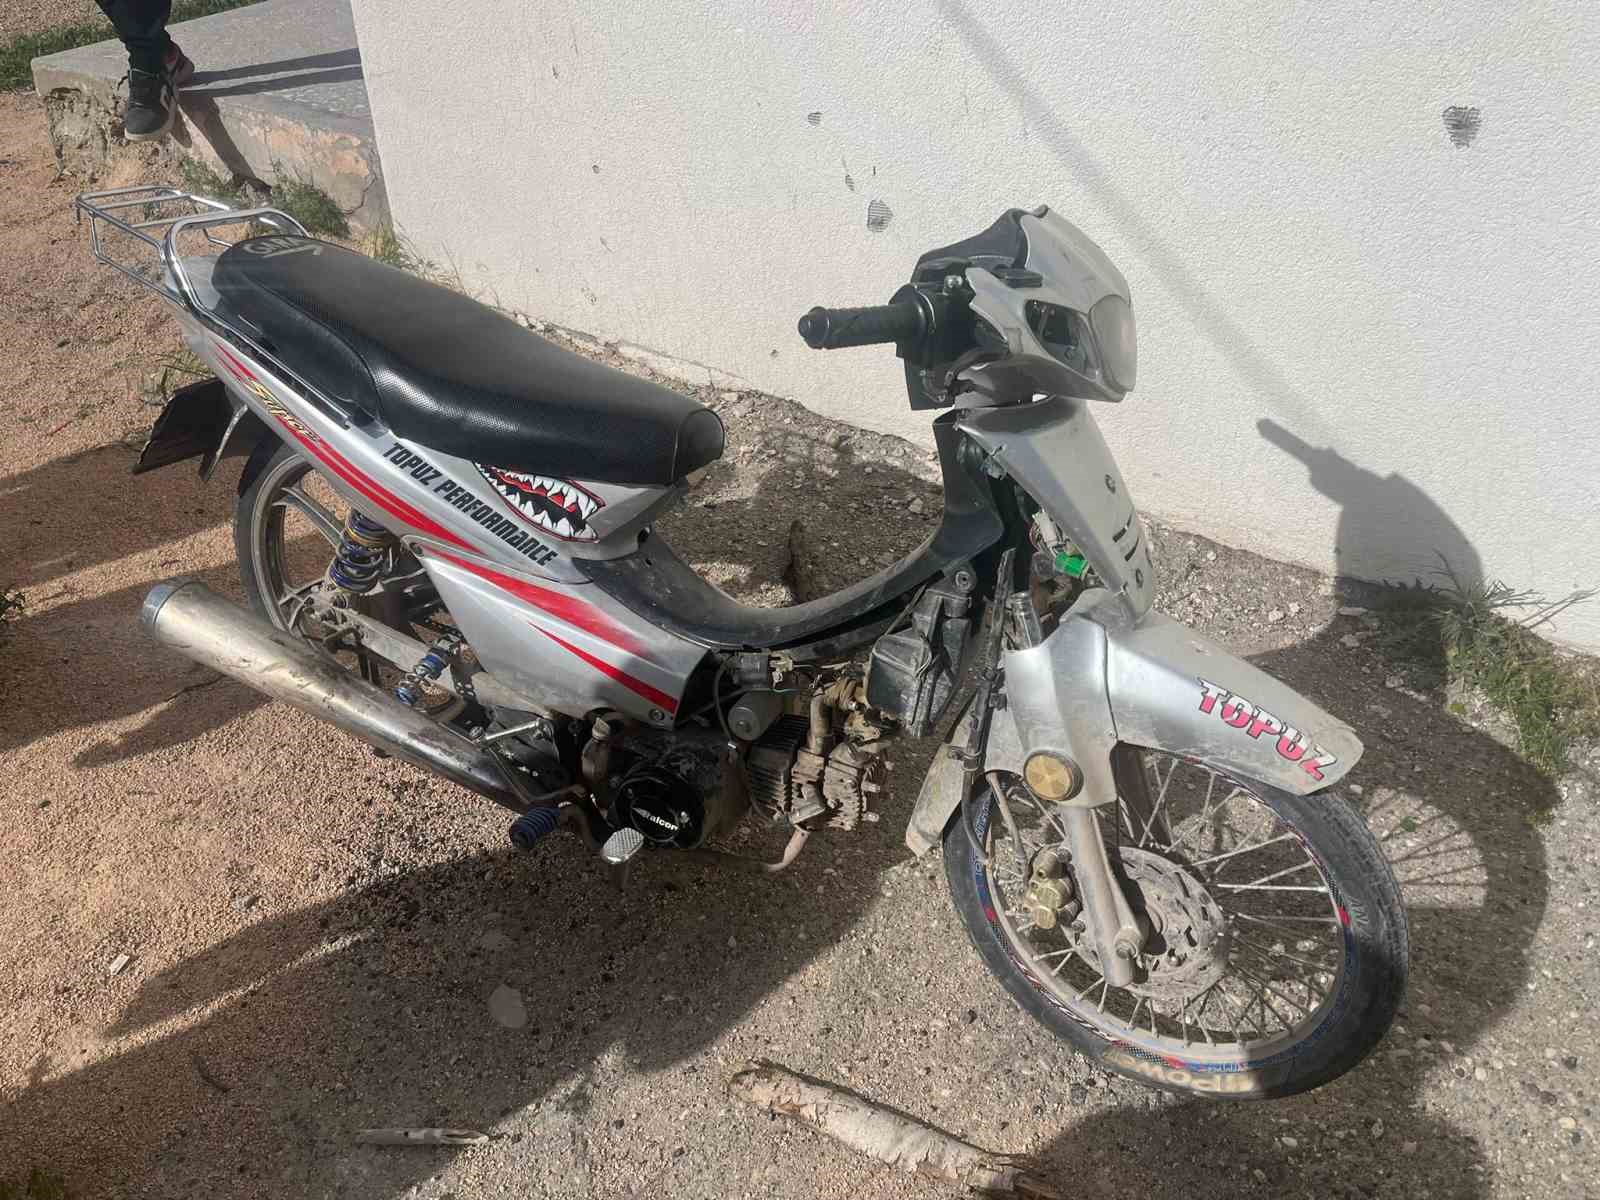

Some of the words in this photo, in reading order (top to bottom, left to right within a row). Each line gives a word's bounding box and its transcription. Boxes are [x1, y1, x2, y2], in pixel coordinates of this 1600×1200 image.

[382, 442, 443, 486] TOPUZ
[433, 479, 558, 566] PERFORMANCE
[1196, 677, 1337, 782] TOPUZ
